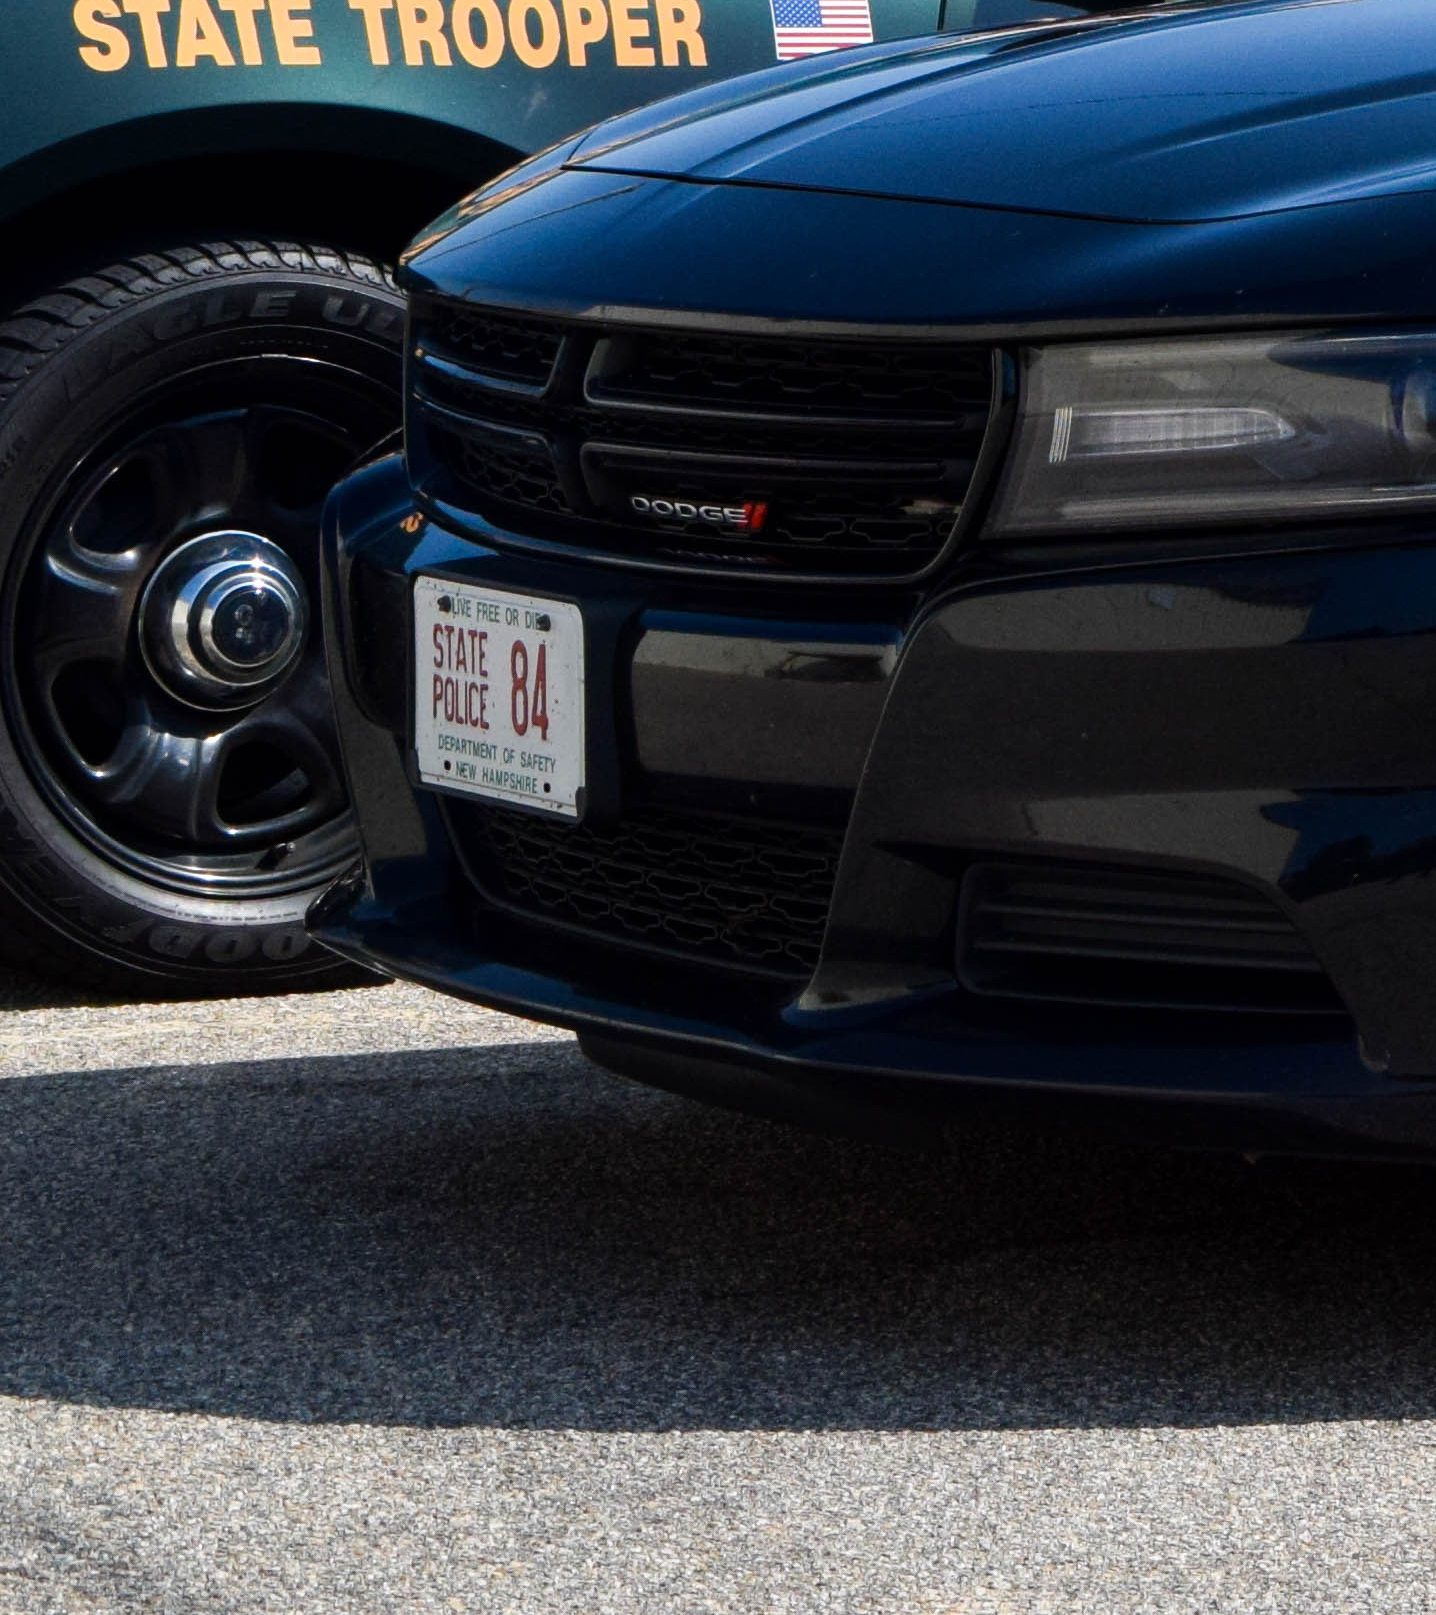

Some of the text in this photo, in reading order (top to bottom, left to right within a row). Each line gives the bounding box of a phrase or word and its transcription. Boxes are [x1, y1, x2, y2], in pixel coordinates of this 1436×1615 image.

[631, 496, 748, 523] DODGE
[451, 596, 472, 618] LIVE
[476, 601, 500, 623] FREE
[505, 607, 519, 626] OR
[432, 623, 489, 678] STATE
[432, 673, 490, 731] POLICE
[510, 639, 549, 741] 84
[438, 733, 556, 774] DEPARTMENT OF SAFETY
[456, 760, 538, 795] NEW HAMPSHIRE
